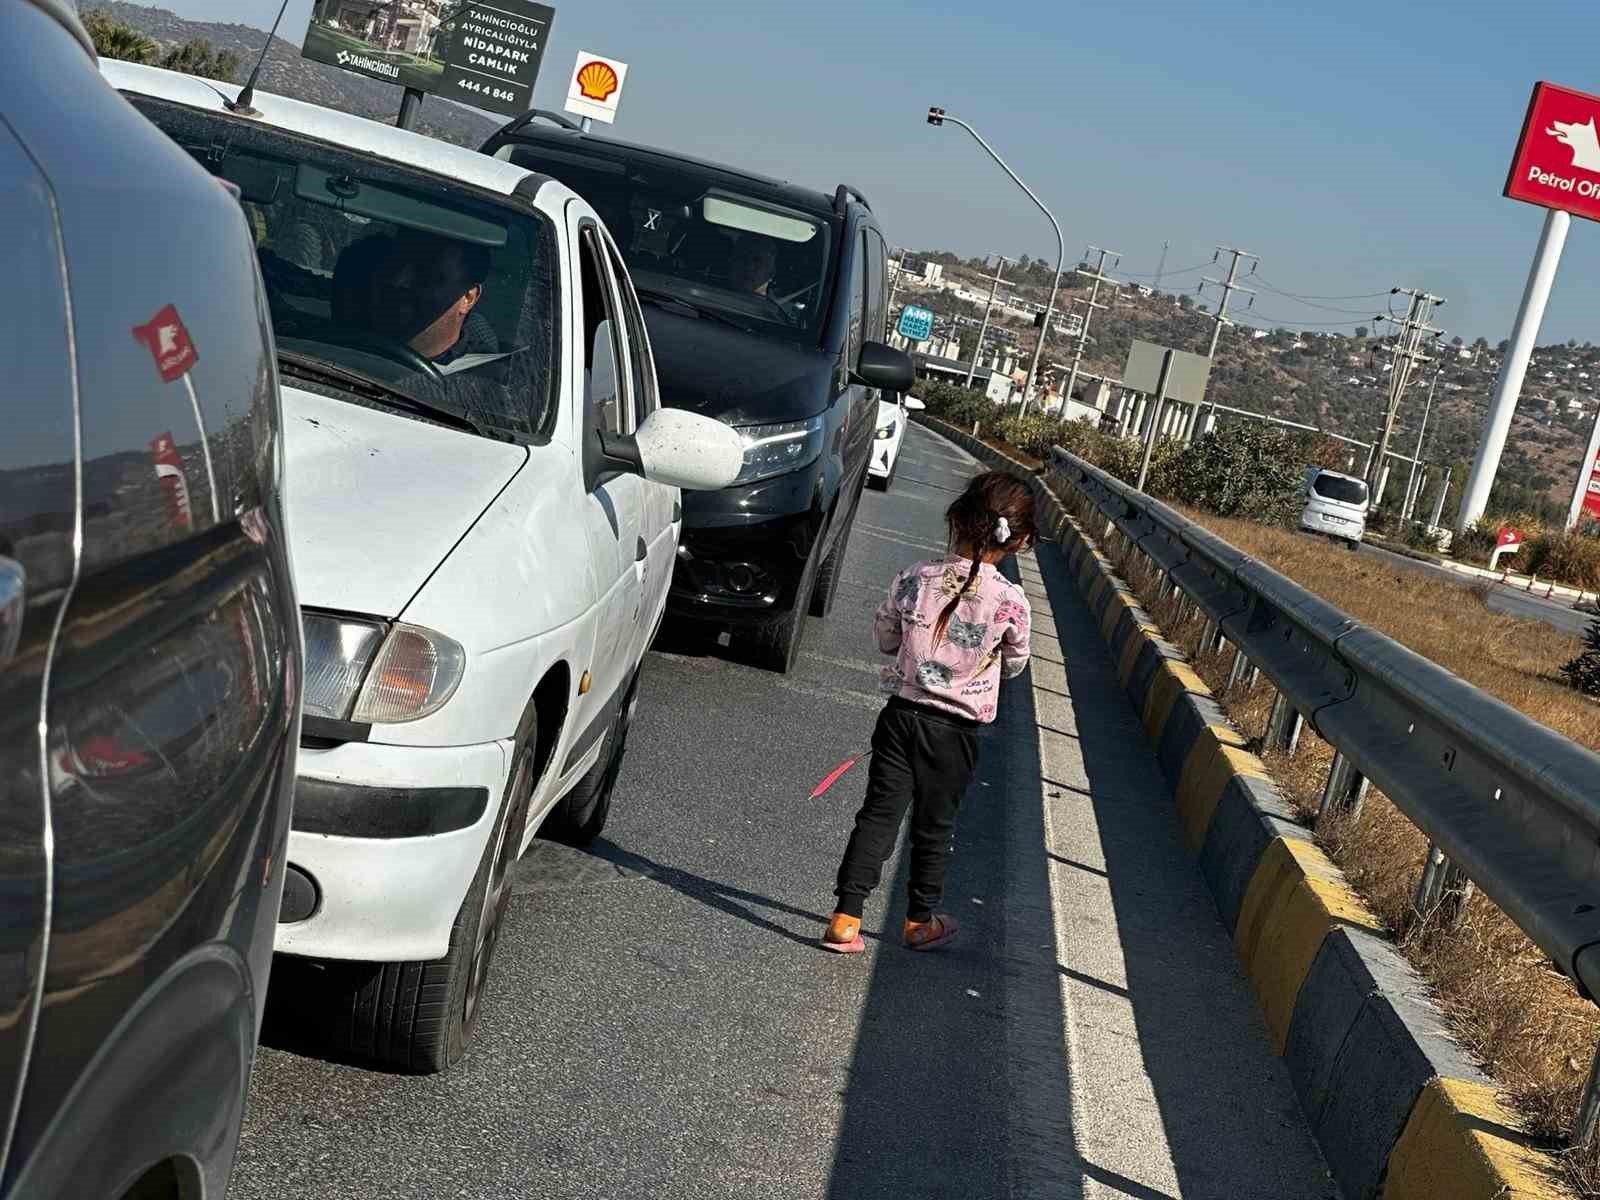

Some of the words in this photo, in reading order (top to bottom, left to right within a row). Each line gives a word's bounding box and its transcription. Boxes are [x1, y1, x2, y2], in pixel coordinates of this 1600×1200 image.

[470, 10, 538, 36] TAHİNCİOĞLU
[462, 22, 537, 50] AYRICALIĞIYLA
[463, 36, 529, 63] NİDAPARK
[350, 54, 399, 77] TAHİNCİOĞLU
[468, 53, 518, 75] ÇAMLIK
[457, 79, 481, 92] 444
[482, 86, 490, 95] 4
[493, 88, 515, 102] 846
[1528, 166, 1576, 191] Petrol
